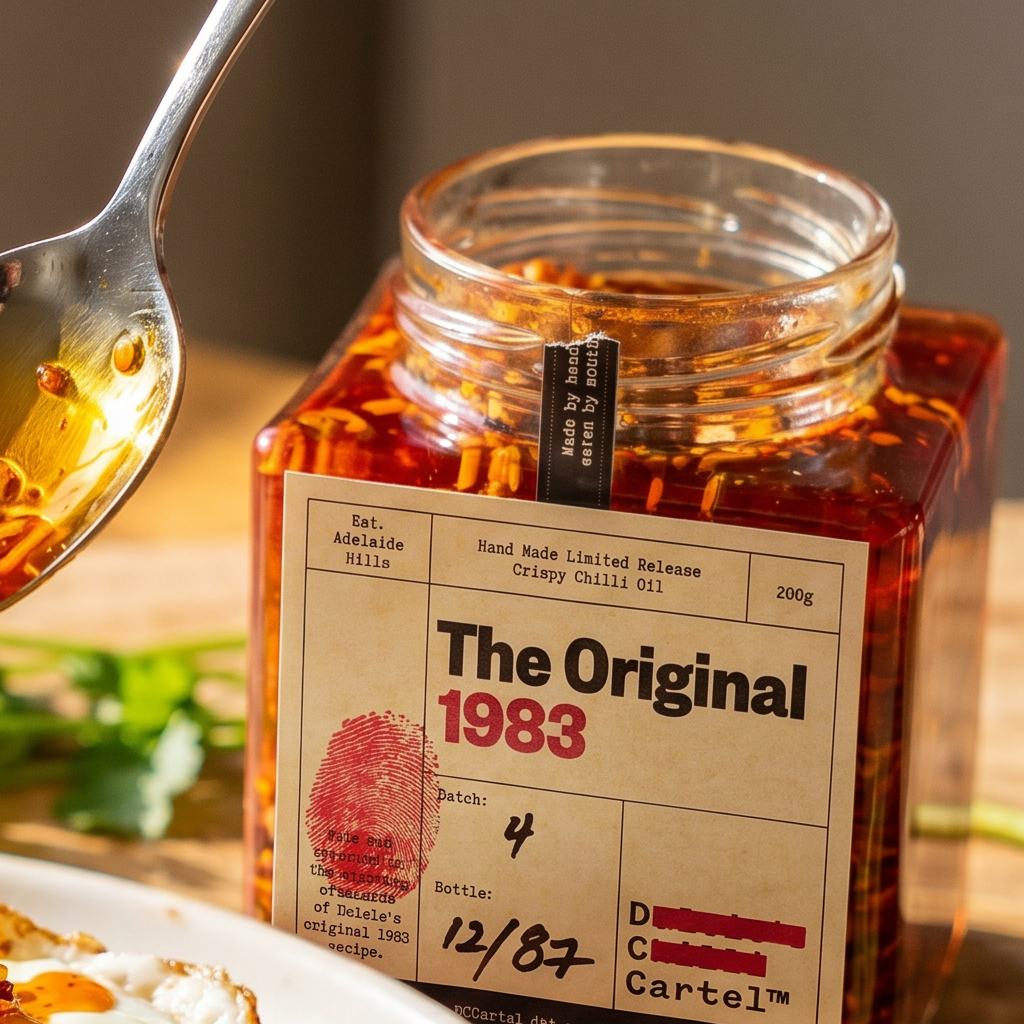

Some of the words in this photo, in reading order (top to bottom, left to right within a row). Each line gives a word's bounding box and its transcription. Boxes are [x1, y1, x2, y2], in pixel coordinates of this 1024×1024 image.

[563, 392, 581, 411] by
[581, 395, 599, 413] by
[333, 531, 404, 551] Adelaide
[345, 552, 391, 569] Hills
[477, 539, 514, 556] Hand
[522, 545, 559, 561] Made
[566, 550, 630, 570] Limited
[637, 558, 702, 579] Release
[512, 563, 567, 585] Crispy
[574, 570, 628, 590] Chilli
[636, 578, 664, 594] Oil
[776, 586, 814, 607] 200g
[436, 619, 552, 687] The
[564, 636, 807, 721] Original
[438, 688, 587, 760] 1983
[503, 812, 535, 859] 4
[434, 881, 492, 900] Bottle:
[314, 901, 330, 914] of
[377, 928, 410, 944] 1983
[442, 916, 595, 982] 12/87
